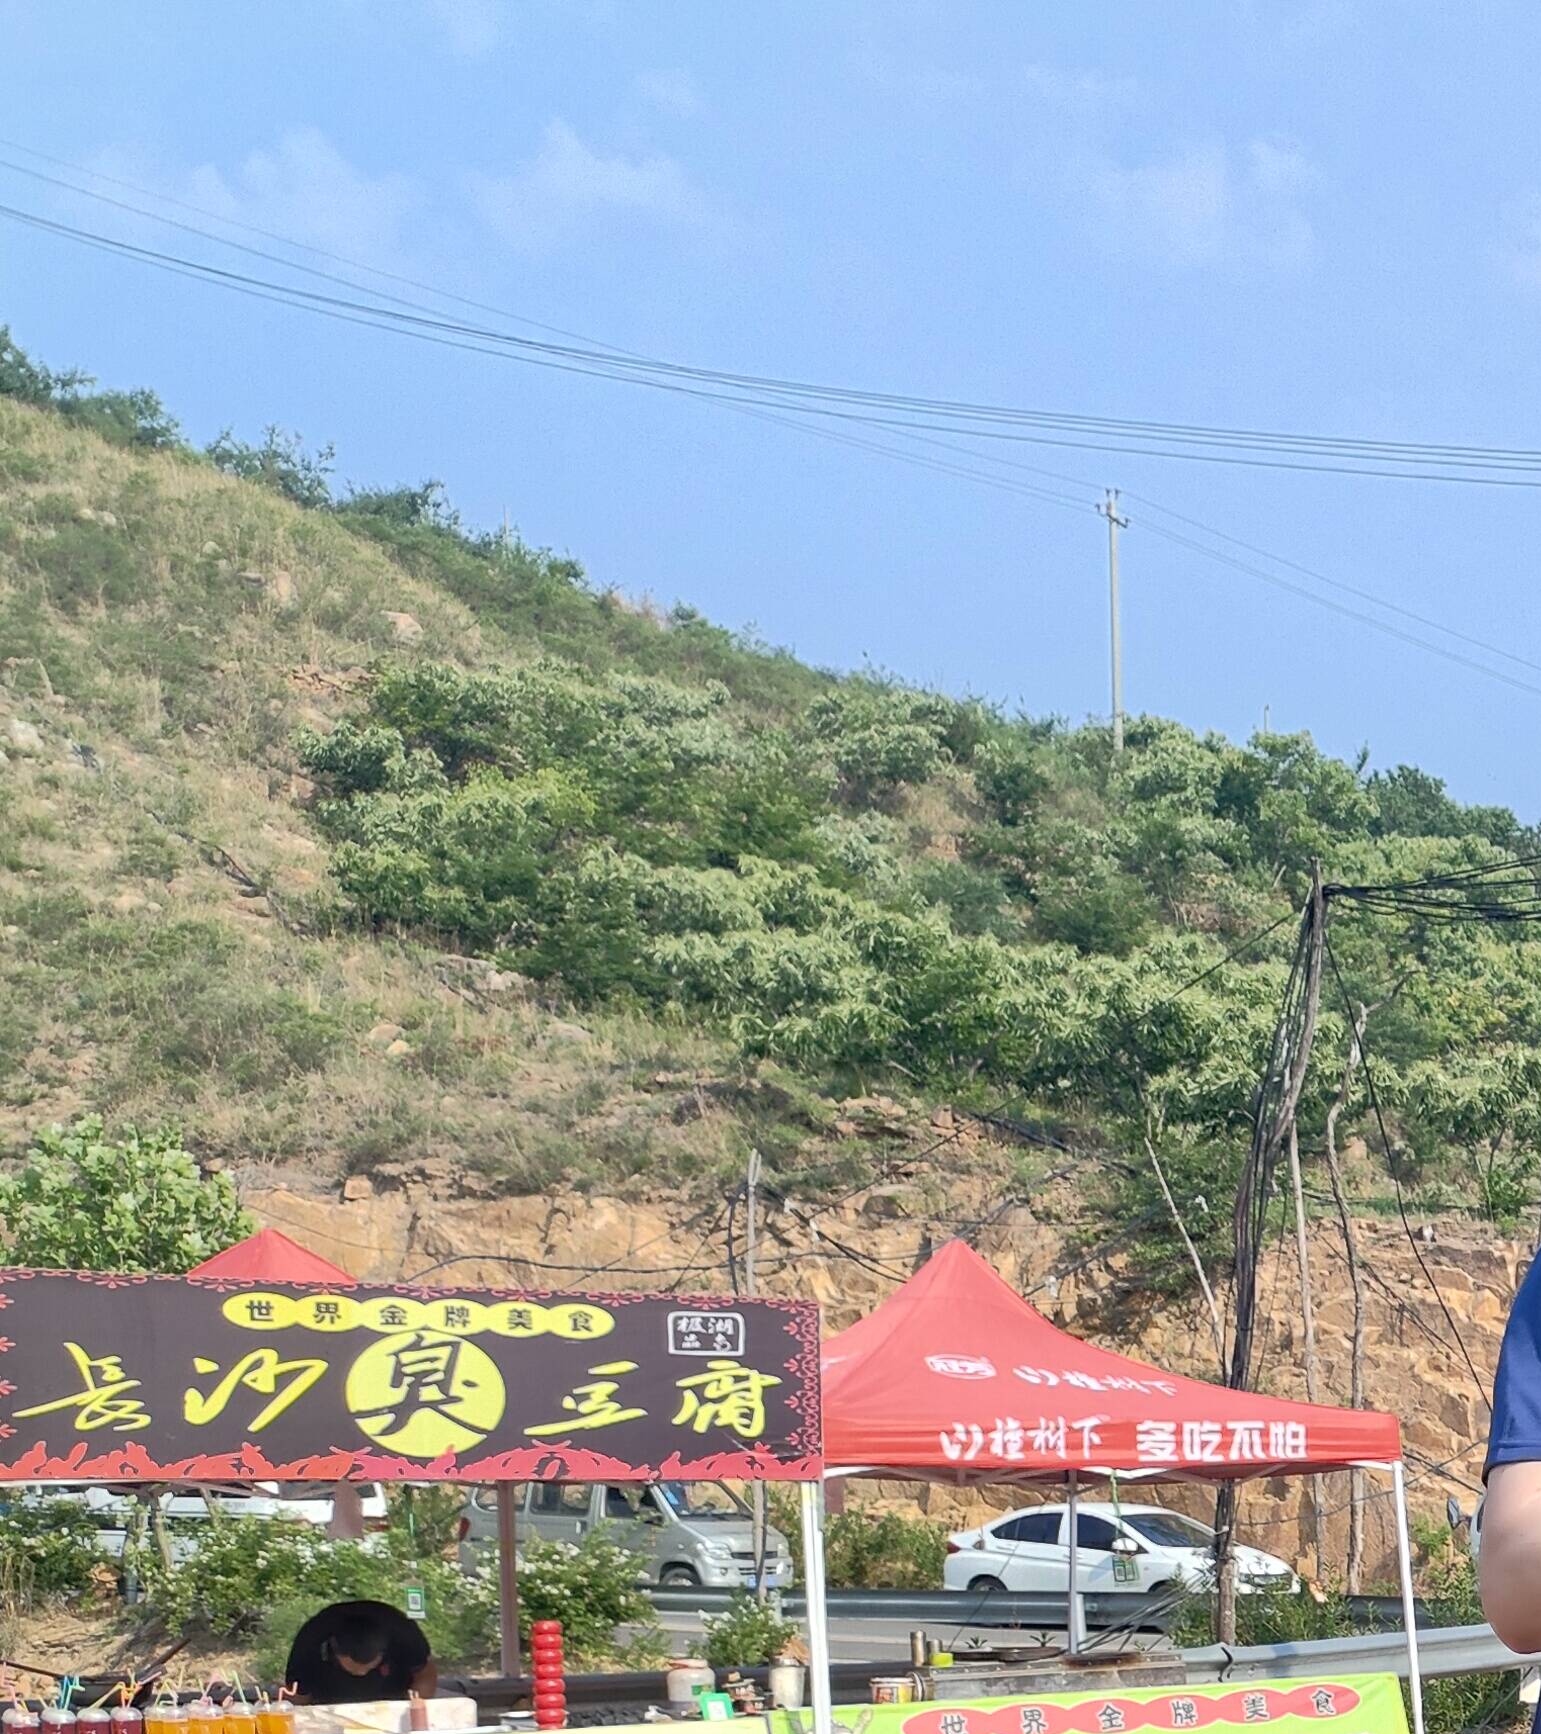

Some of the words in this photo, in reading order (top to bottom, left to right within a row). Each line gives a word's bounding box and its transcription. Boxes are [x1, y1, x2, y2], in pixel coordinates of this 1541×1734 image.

[245, 1299, 595, 1336] 世界金牌美食
[940, 1414, 1111, 1461] 山楂树下
[1136, 1419, 1308, 1463] 多吃不怕
